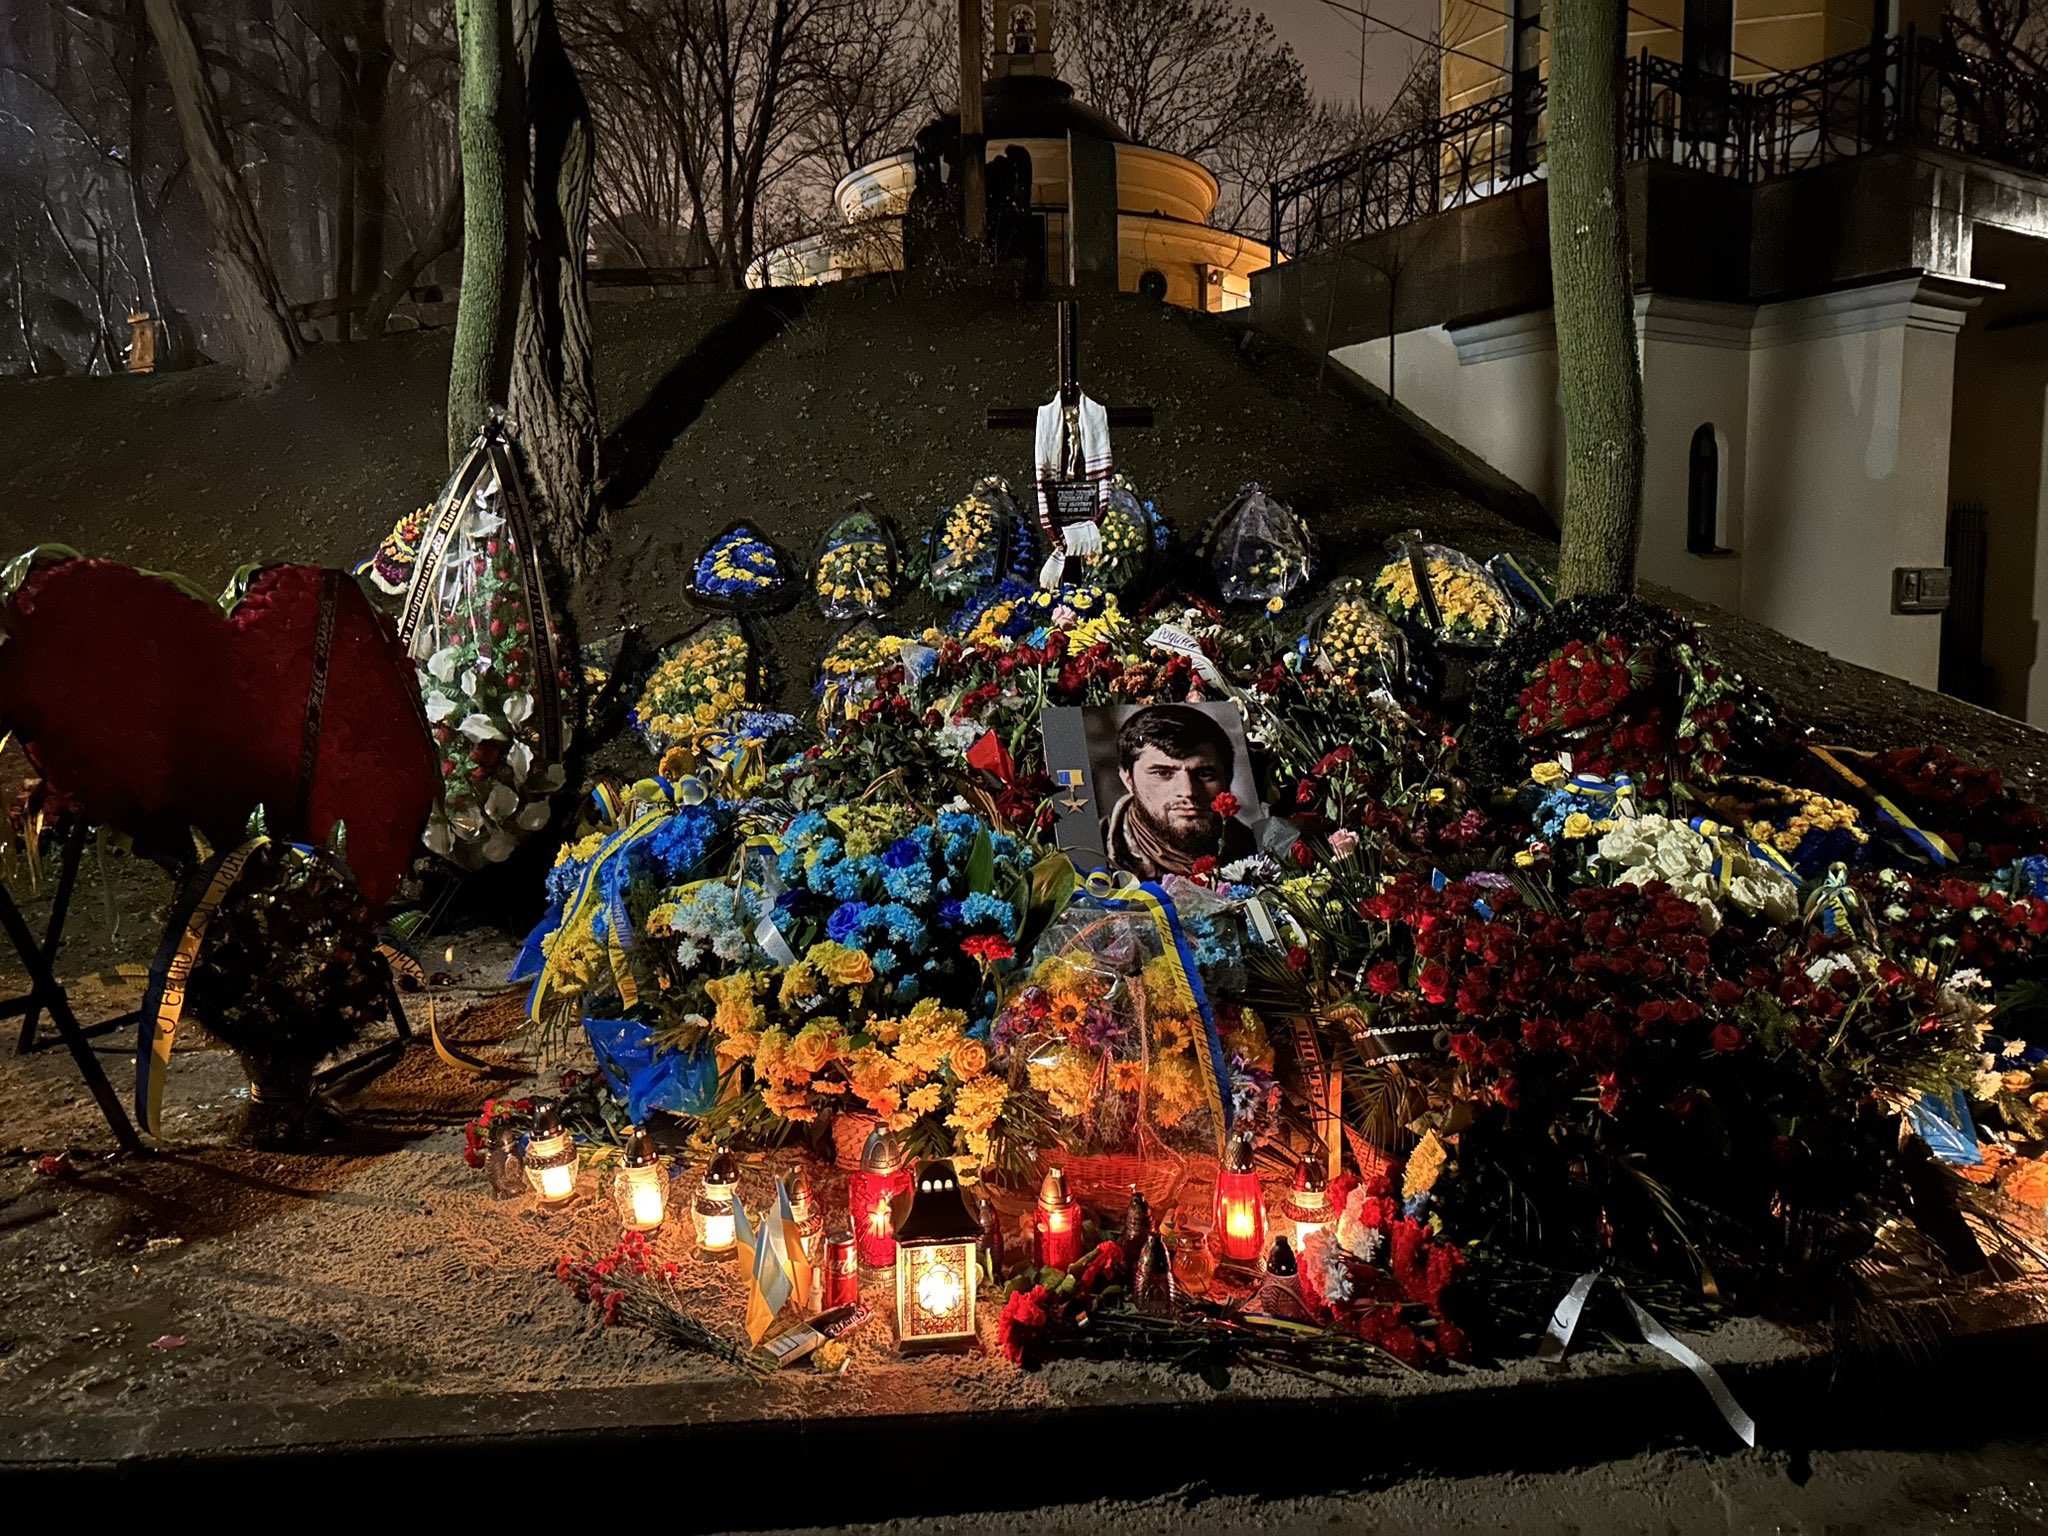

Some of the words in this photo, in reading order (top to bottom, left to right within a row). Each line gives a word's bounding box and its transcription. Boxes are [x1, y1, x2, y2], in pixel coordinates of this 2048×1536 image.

[408, 552, 438, 629] побратиму
[440, 498, 460, 532] Вінчі
[532, 607, 545, 633] СБУ
